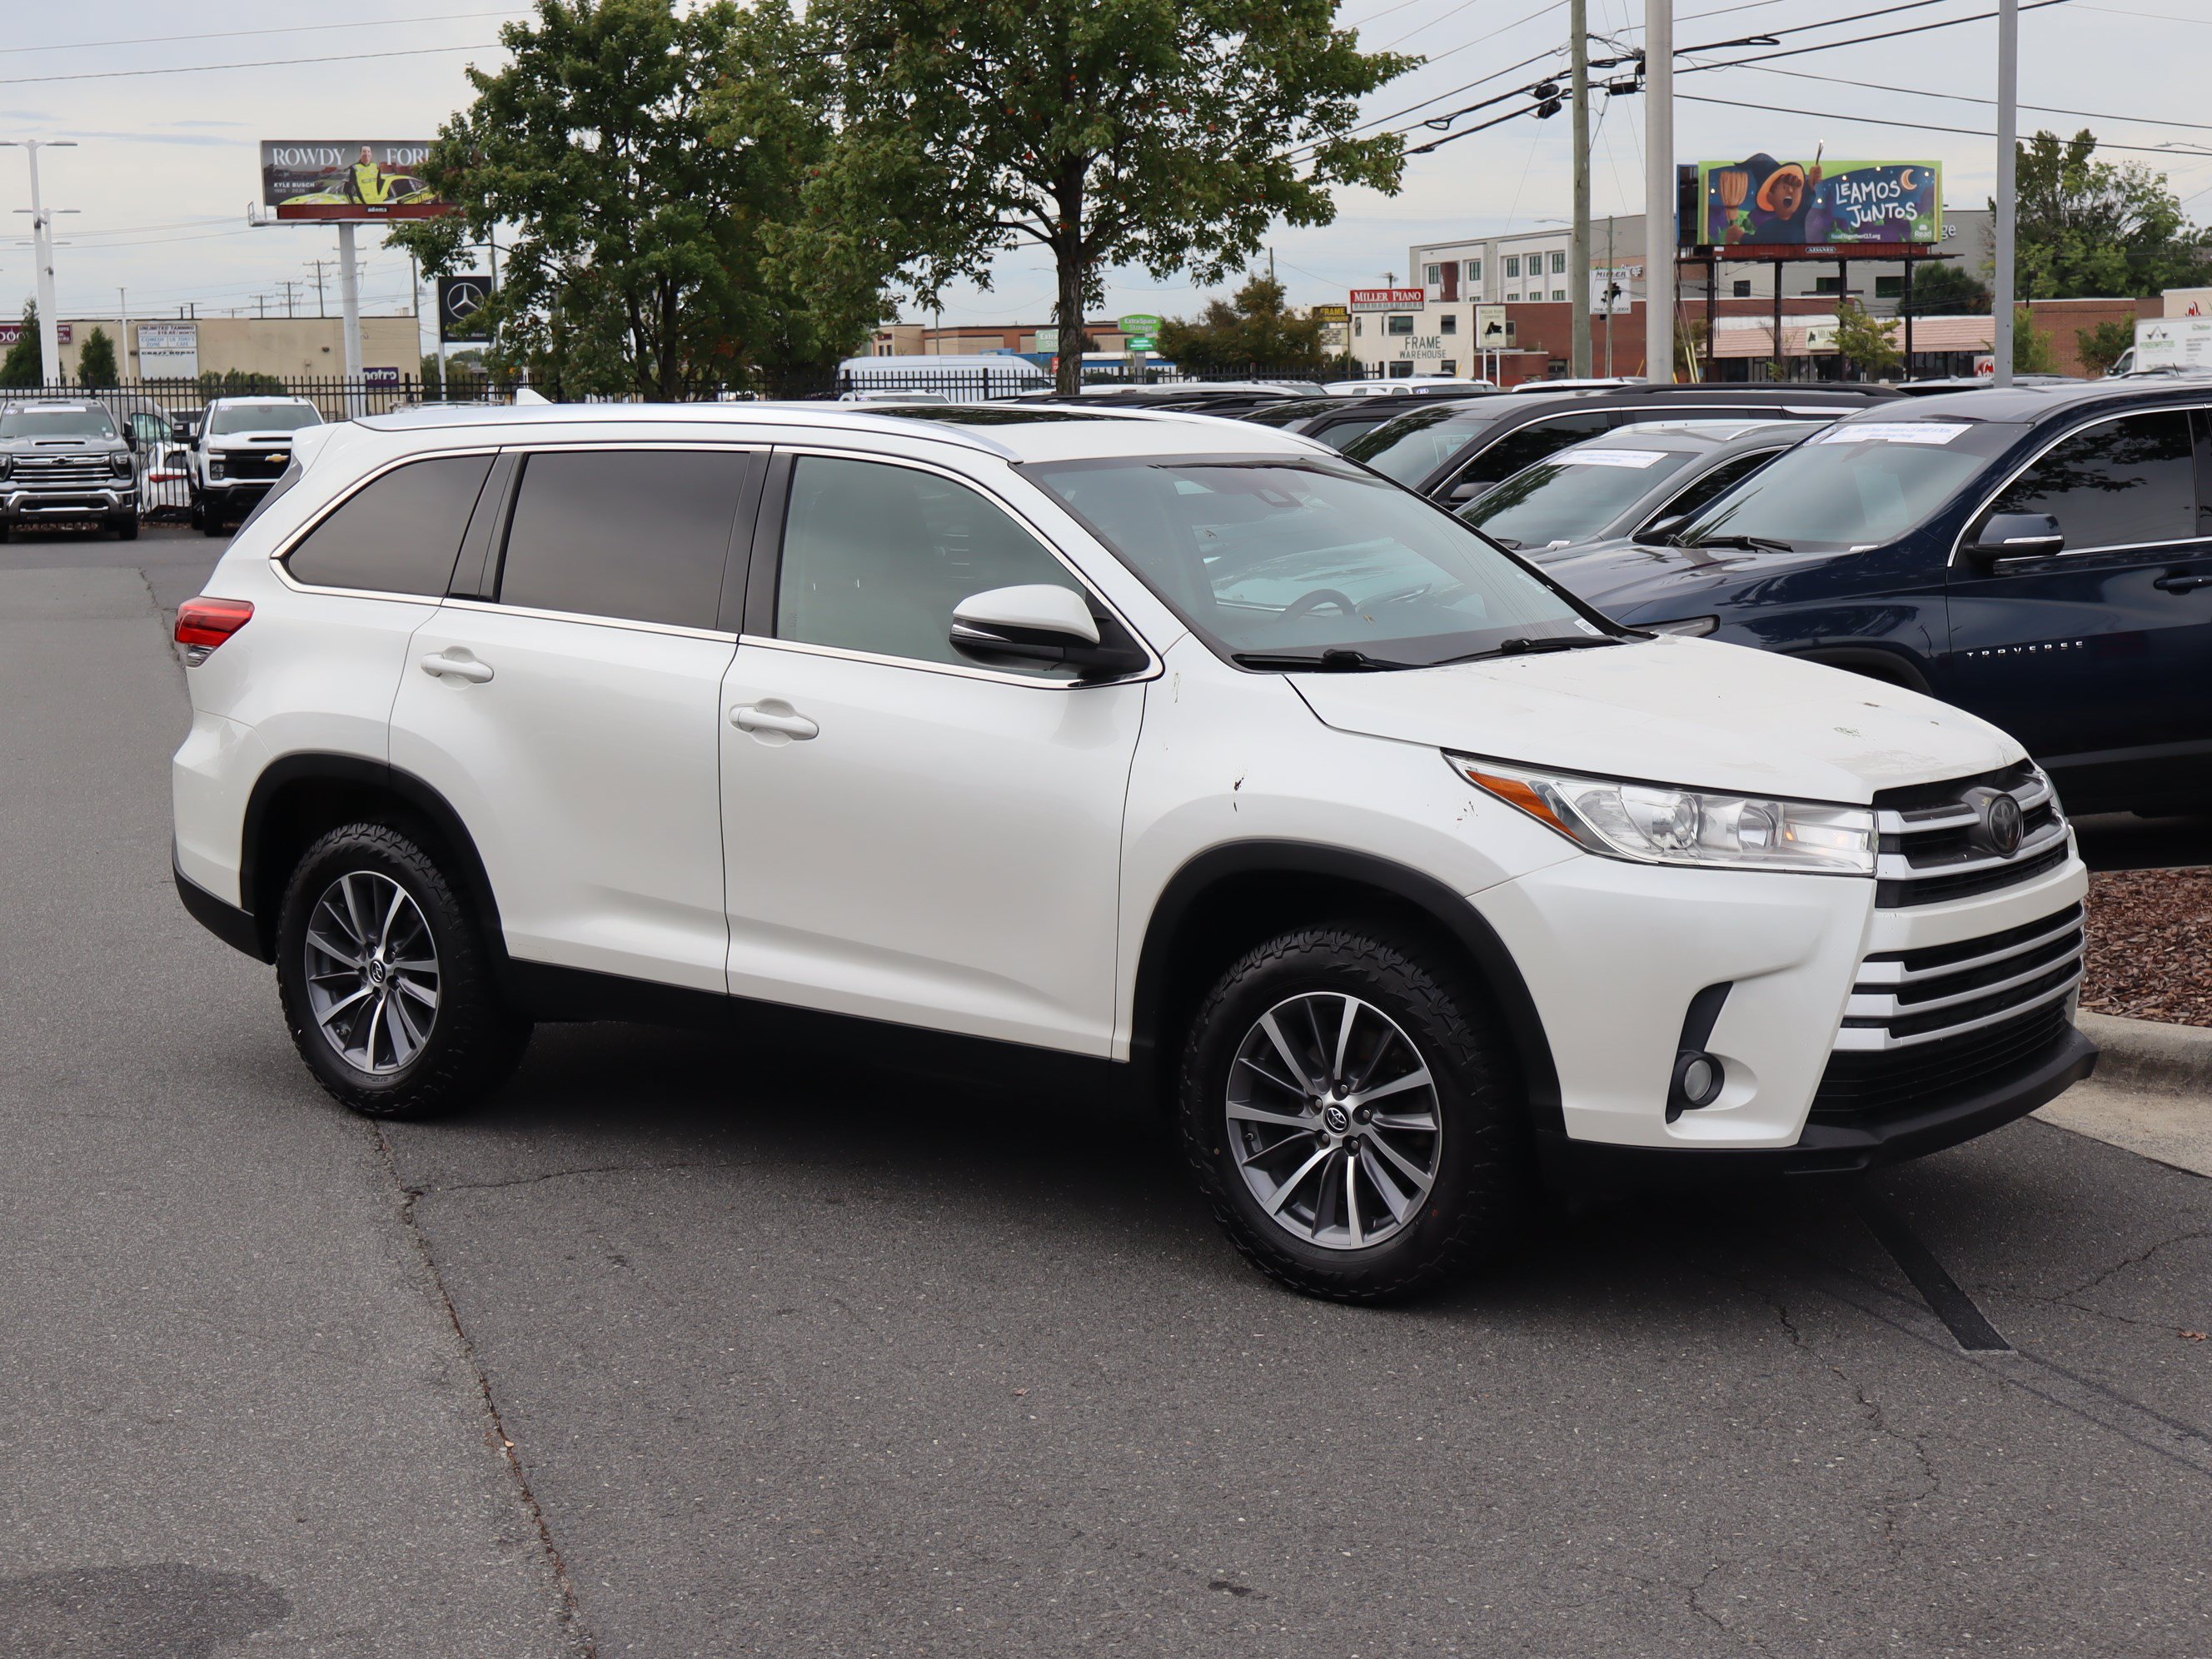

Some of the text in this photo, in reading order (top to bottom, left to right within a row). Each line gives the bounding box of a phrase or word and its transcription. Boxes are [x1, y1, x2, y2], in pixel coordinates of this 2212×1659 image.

[272, 147, 346, 166] ROWDY
[1836, 180, 1901, 205] LEAMOS
[1914, 229, 1932, 239] Read
[1354, 291, 1422, 301] MILLER PIANO
[1405, 336, 1441, 350] FRAME
[1399, 350, 1447, 359] WAREHOUSE
[1966, 640, 2083, 660] TRAVERSE
